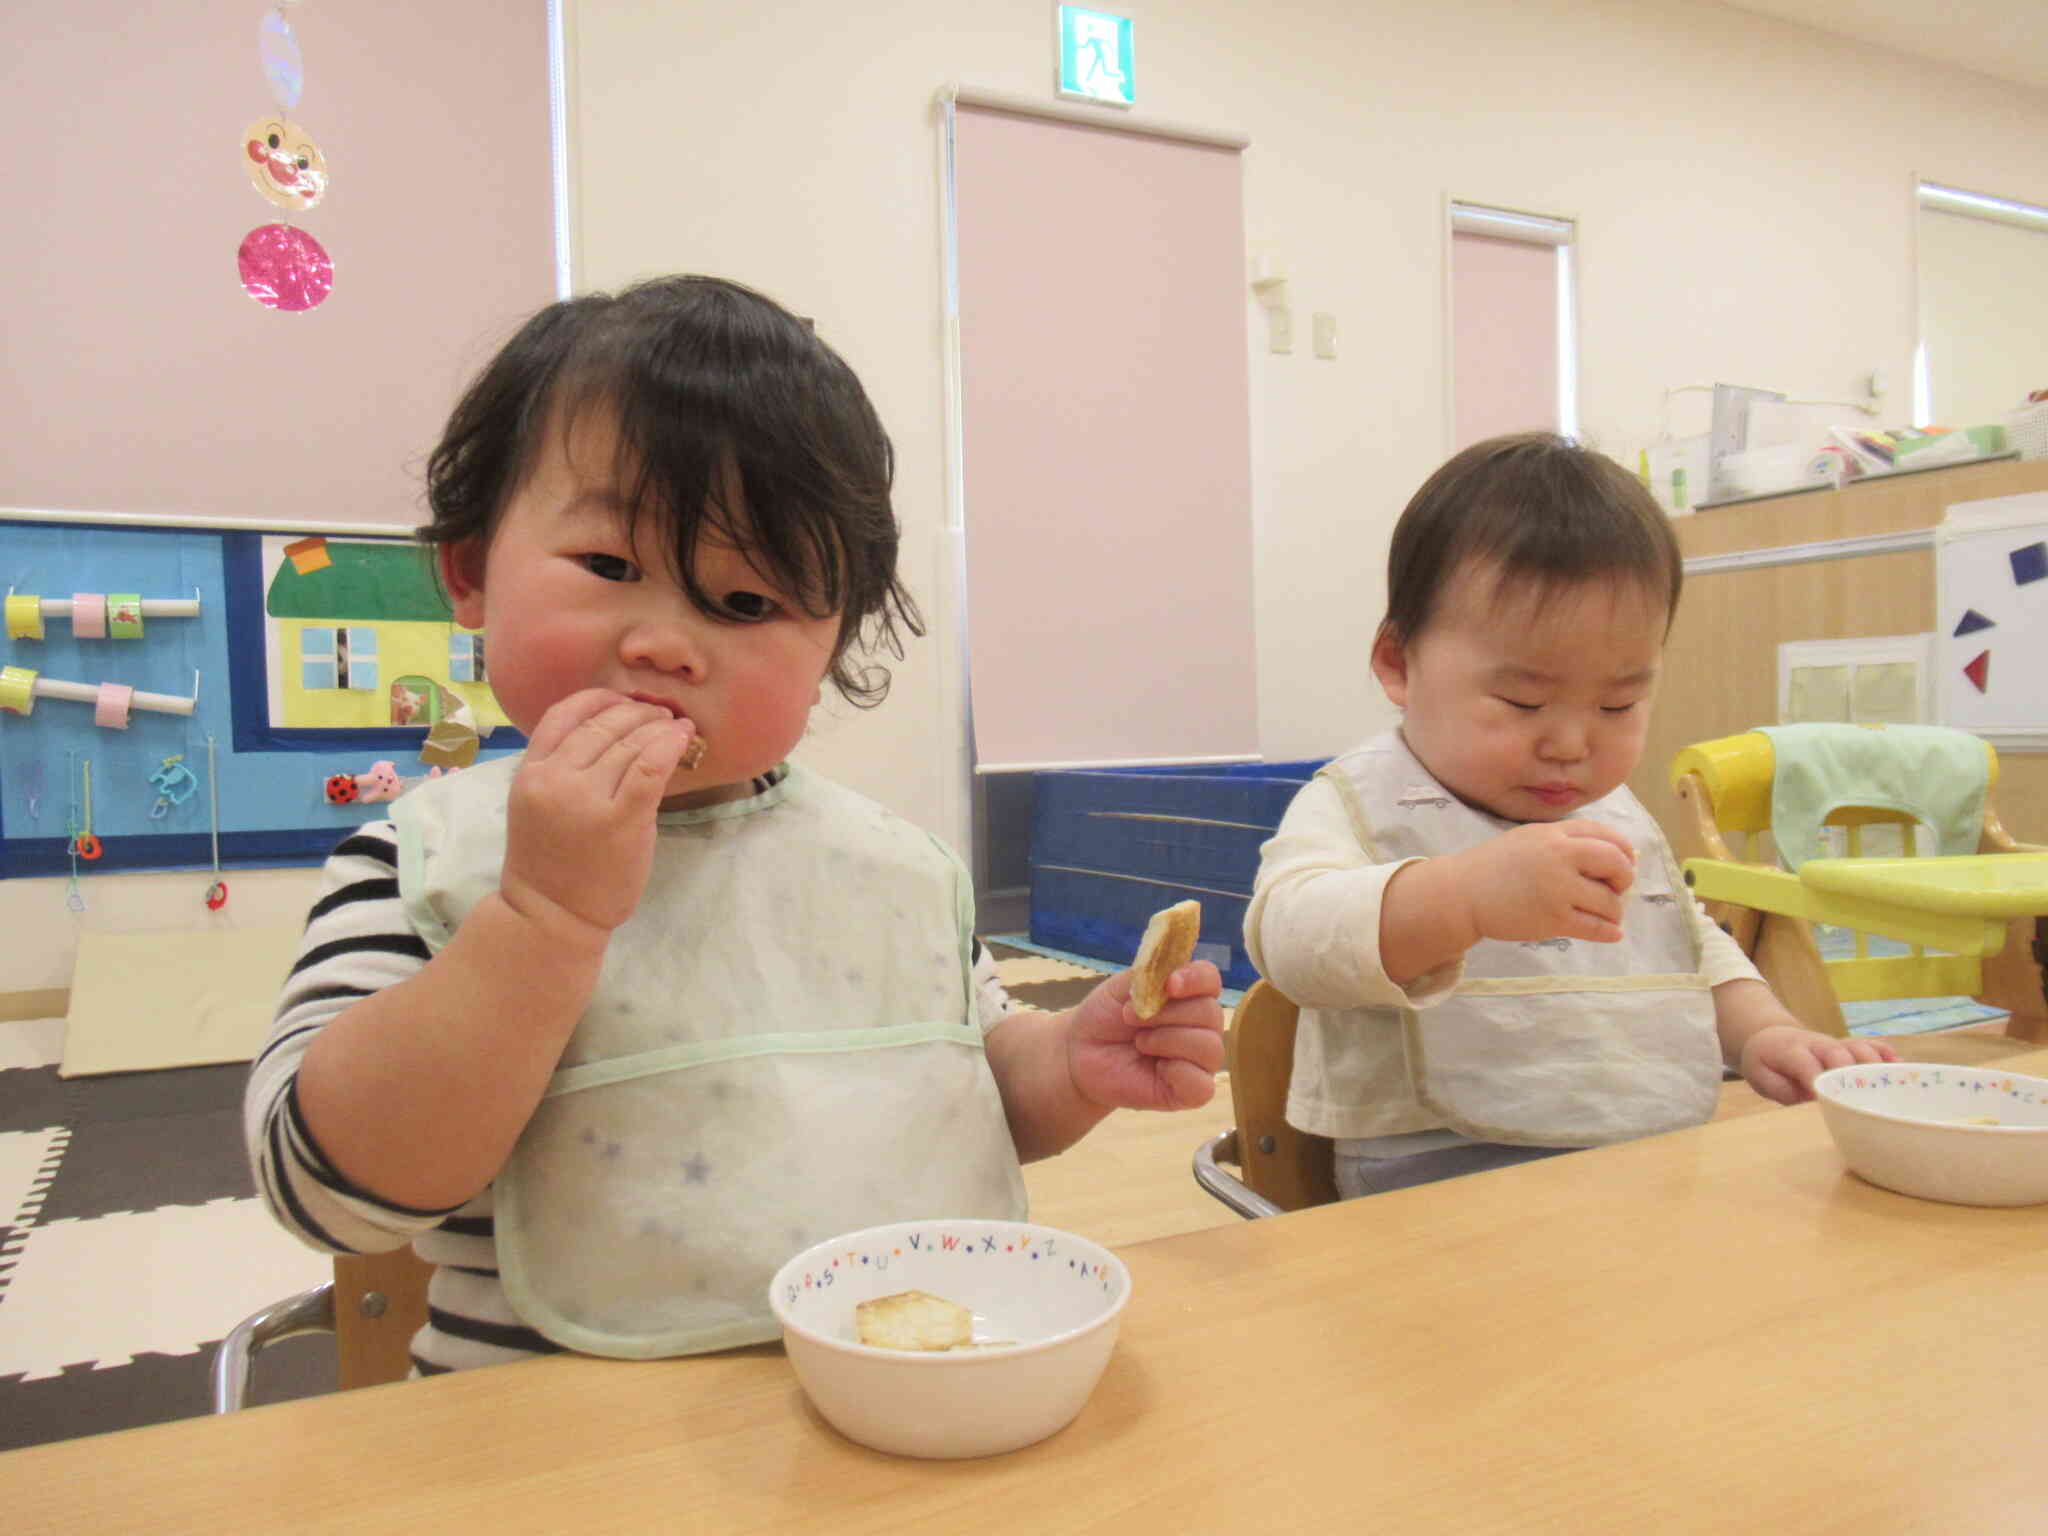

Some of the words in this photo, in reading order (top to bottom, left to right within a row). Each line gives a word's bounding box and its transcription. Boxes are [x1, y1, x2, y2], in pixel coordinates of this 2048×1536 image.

[909, 1231, 921, 1250] V
[943, 1234, 961, 1251] W
[981, 1234, 997, 1253] X
